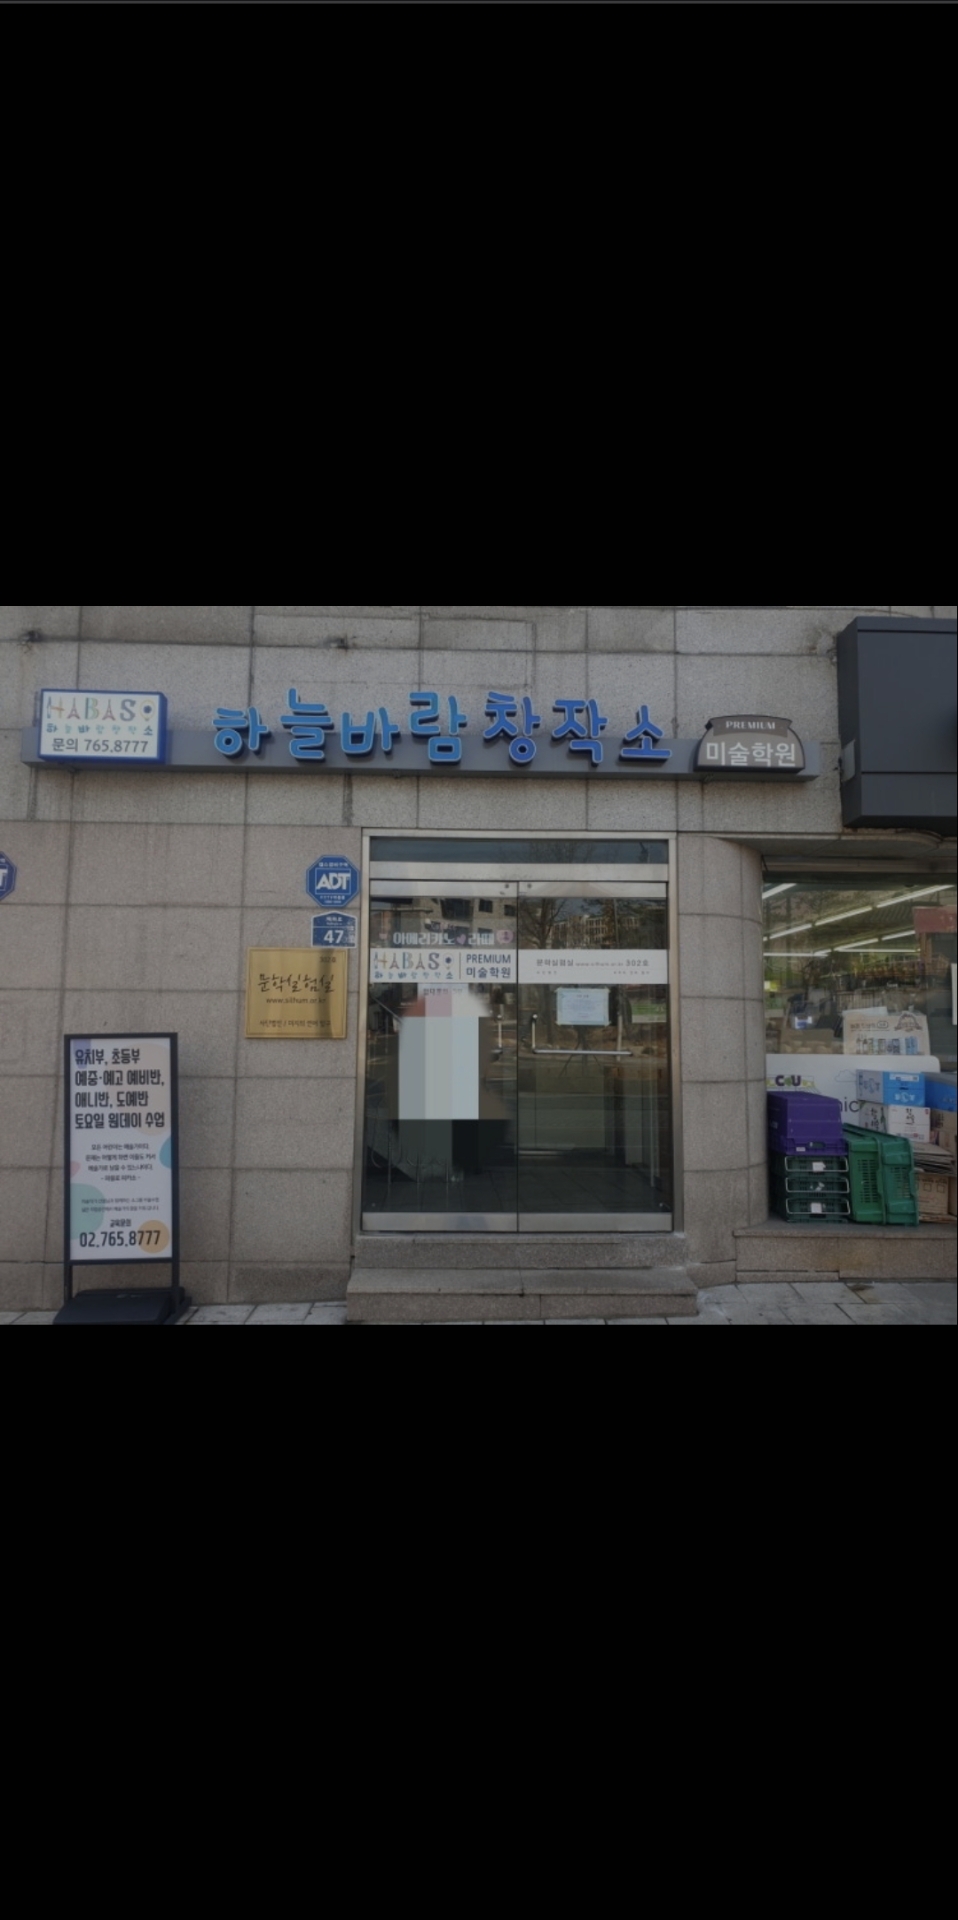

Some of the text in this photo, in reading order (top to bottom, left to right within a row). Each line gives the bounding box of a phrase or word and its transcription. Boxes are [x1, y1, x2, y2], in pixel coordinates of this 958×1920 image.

[725, 721, 776, 730] PREMIUM
[52, 738, 149, 753] 문의 765.8777
[706, 741, 796, 767] 미술학원
[316, 872, 351, 890] ADT
[324, 930, 344, 944] 47
[393, 932, 456, 945] 아메리카노
[466, 954, 511, 964] PREMIUM
[626, 959, 650, 967] 302호
[466, 967, 511, 979] 미술학원
[258, 973, 335, 994] 문학실험실
[75, 1048, 140, 1065] 유치부, 초등부
[127, 1069, 165, 1086] 예비반,
[75, 1091, 149, 1108] 애니반, 도예반
[75, 1112, 165, 1129] 토요일 원데이 수업
[79, 1230, 161, 1247] 02.765.8777
